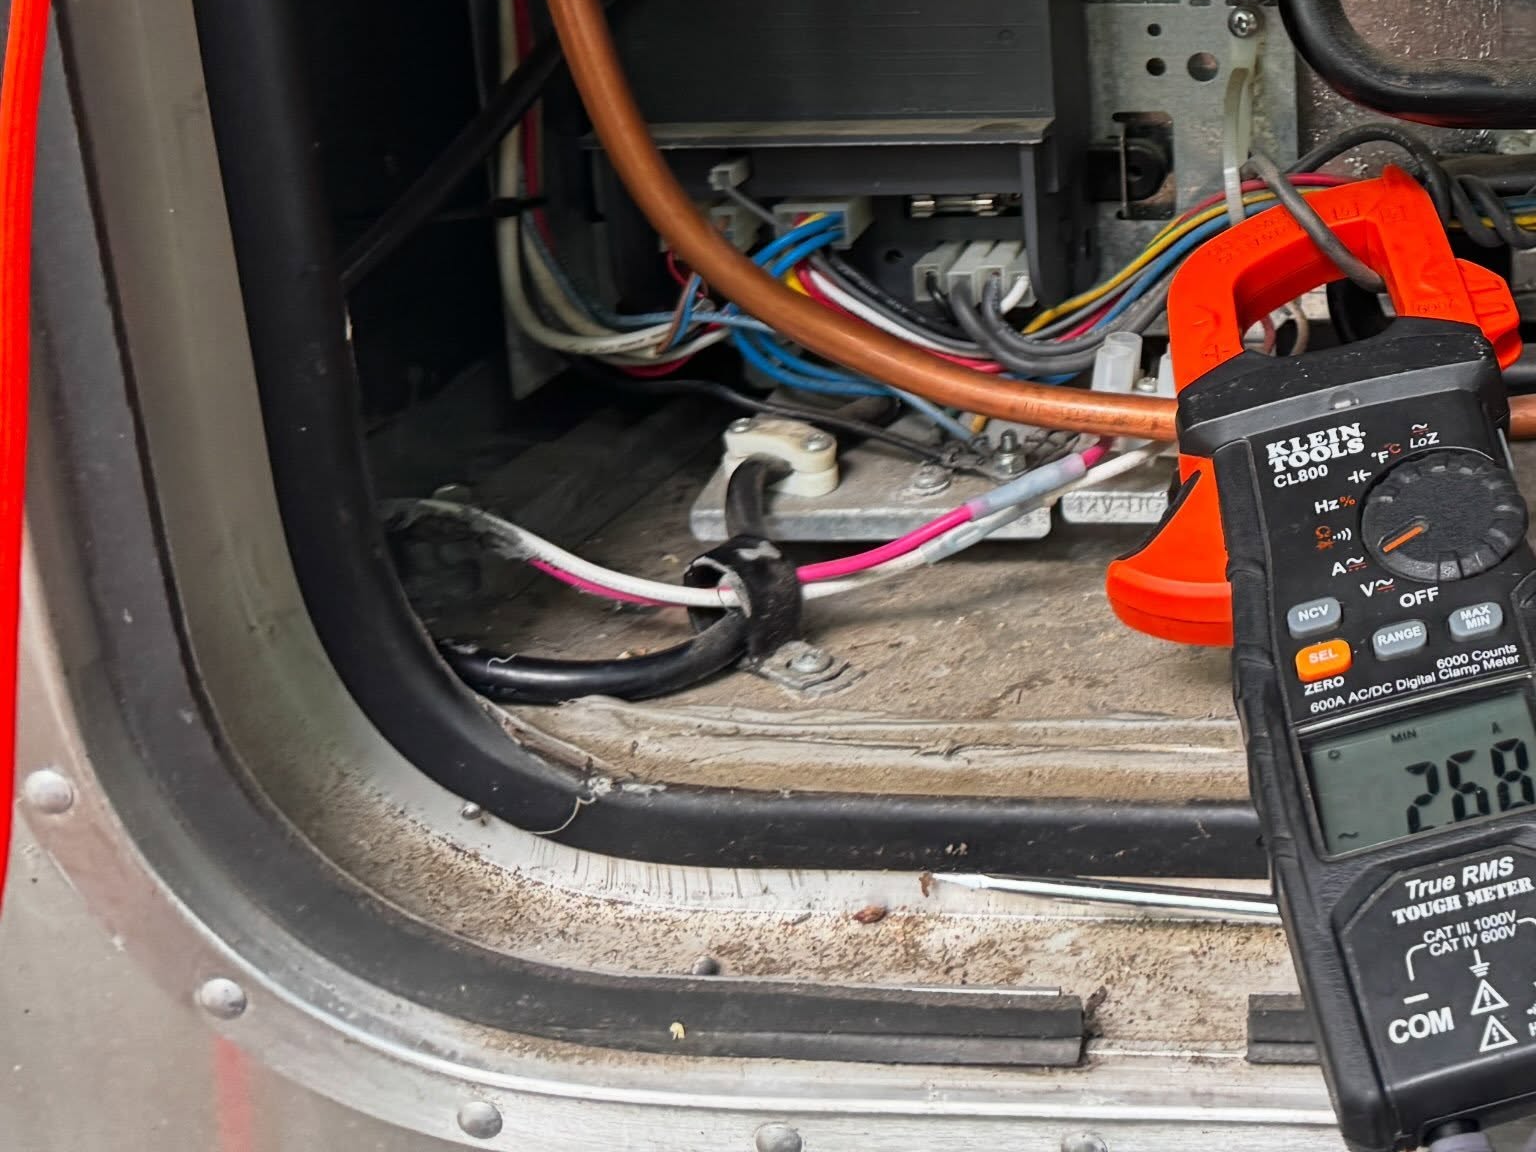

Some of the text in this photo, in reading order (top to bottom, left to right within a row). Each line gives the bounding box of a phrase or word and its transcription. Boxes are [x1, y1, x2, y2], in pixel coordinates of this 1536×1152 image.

[1265, 422, 1363, 459] KLEIN
[1410, 432, 1440, 448] LoZ
[1268, 438, 1365, 473] TOOLS
[1273, 464, 1329, 488] CL800
[1399, 586, 1439, 608] OFF
[1298, 604, 1330, 622] NCV
[1460, 605, 1491, 621] MAX
[1465, 615, 1491, 630] MIN
[1377, 625, 1422, 647] RANGE
[1308, 648, 1338, 664] SEL
[1436, 643, 1518, 670] 6000 Counts
[1304, 676, 1345, 696] ZERO
[1310, 654, 1520, 714] 600A AC/DC Digital Clamp Meter
[1391, 728, 1417, 743] MIN
[1491, 721, 1502, 735] A
[1405, 856, 1515, 900] True RMS
[1392, 877, 1535, 924] TOUGH METER
[1423, 909, 1516, 943] CAT III 1000V
[1429, 924, 1517, 956] CAT IV 600V
[1388, 1006, 1455, 1044] COM
